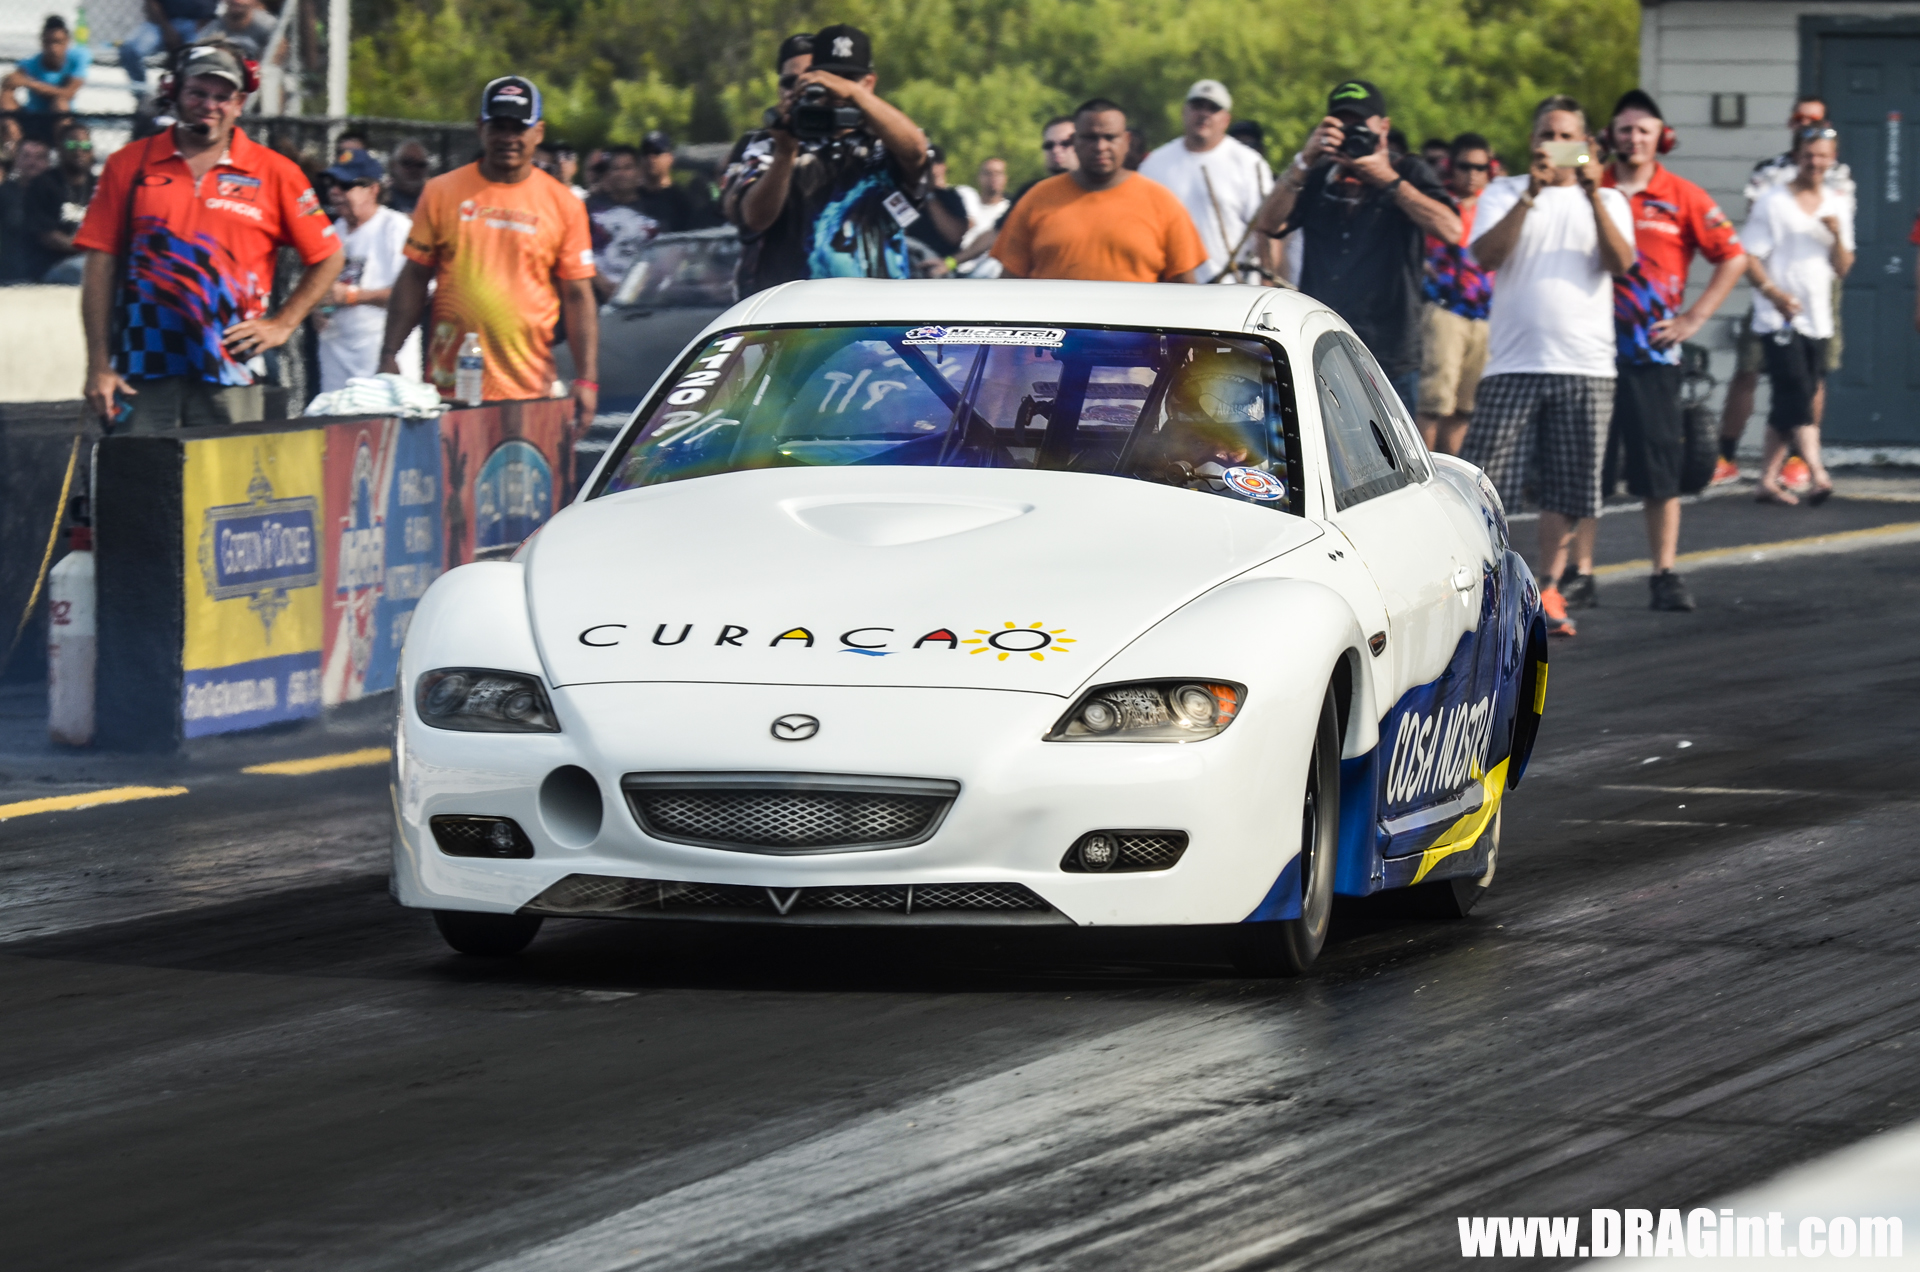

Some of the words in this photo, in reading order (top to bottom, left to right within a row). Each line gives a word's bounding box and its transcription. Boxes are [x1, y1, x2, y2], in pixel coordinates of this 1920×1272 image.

[948, 328, 1058, 338] MicroTech
[1386, 706, 1444, 806] COSA
[1431, 690, 1498, 794] NOSTRA
